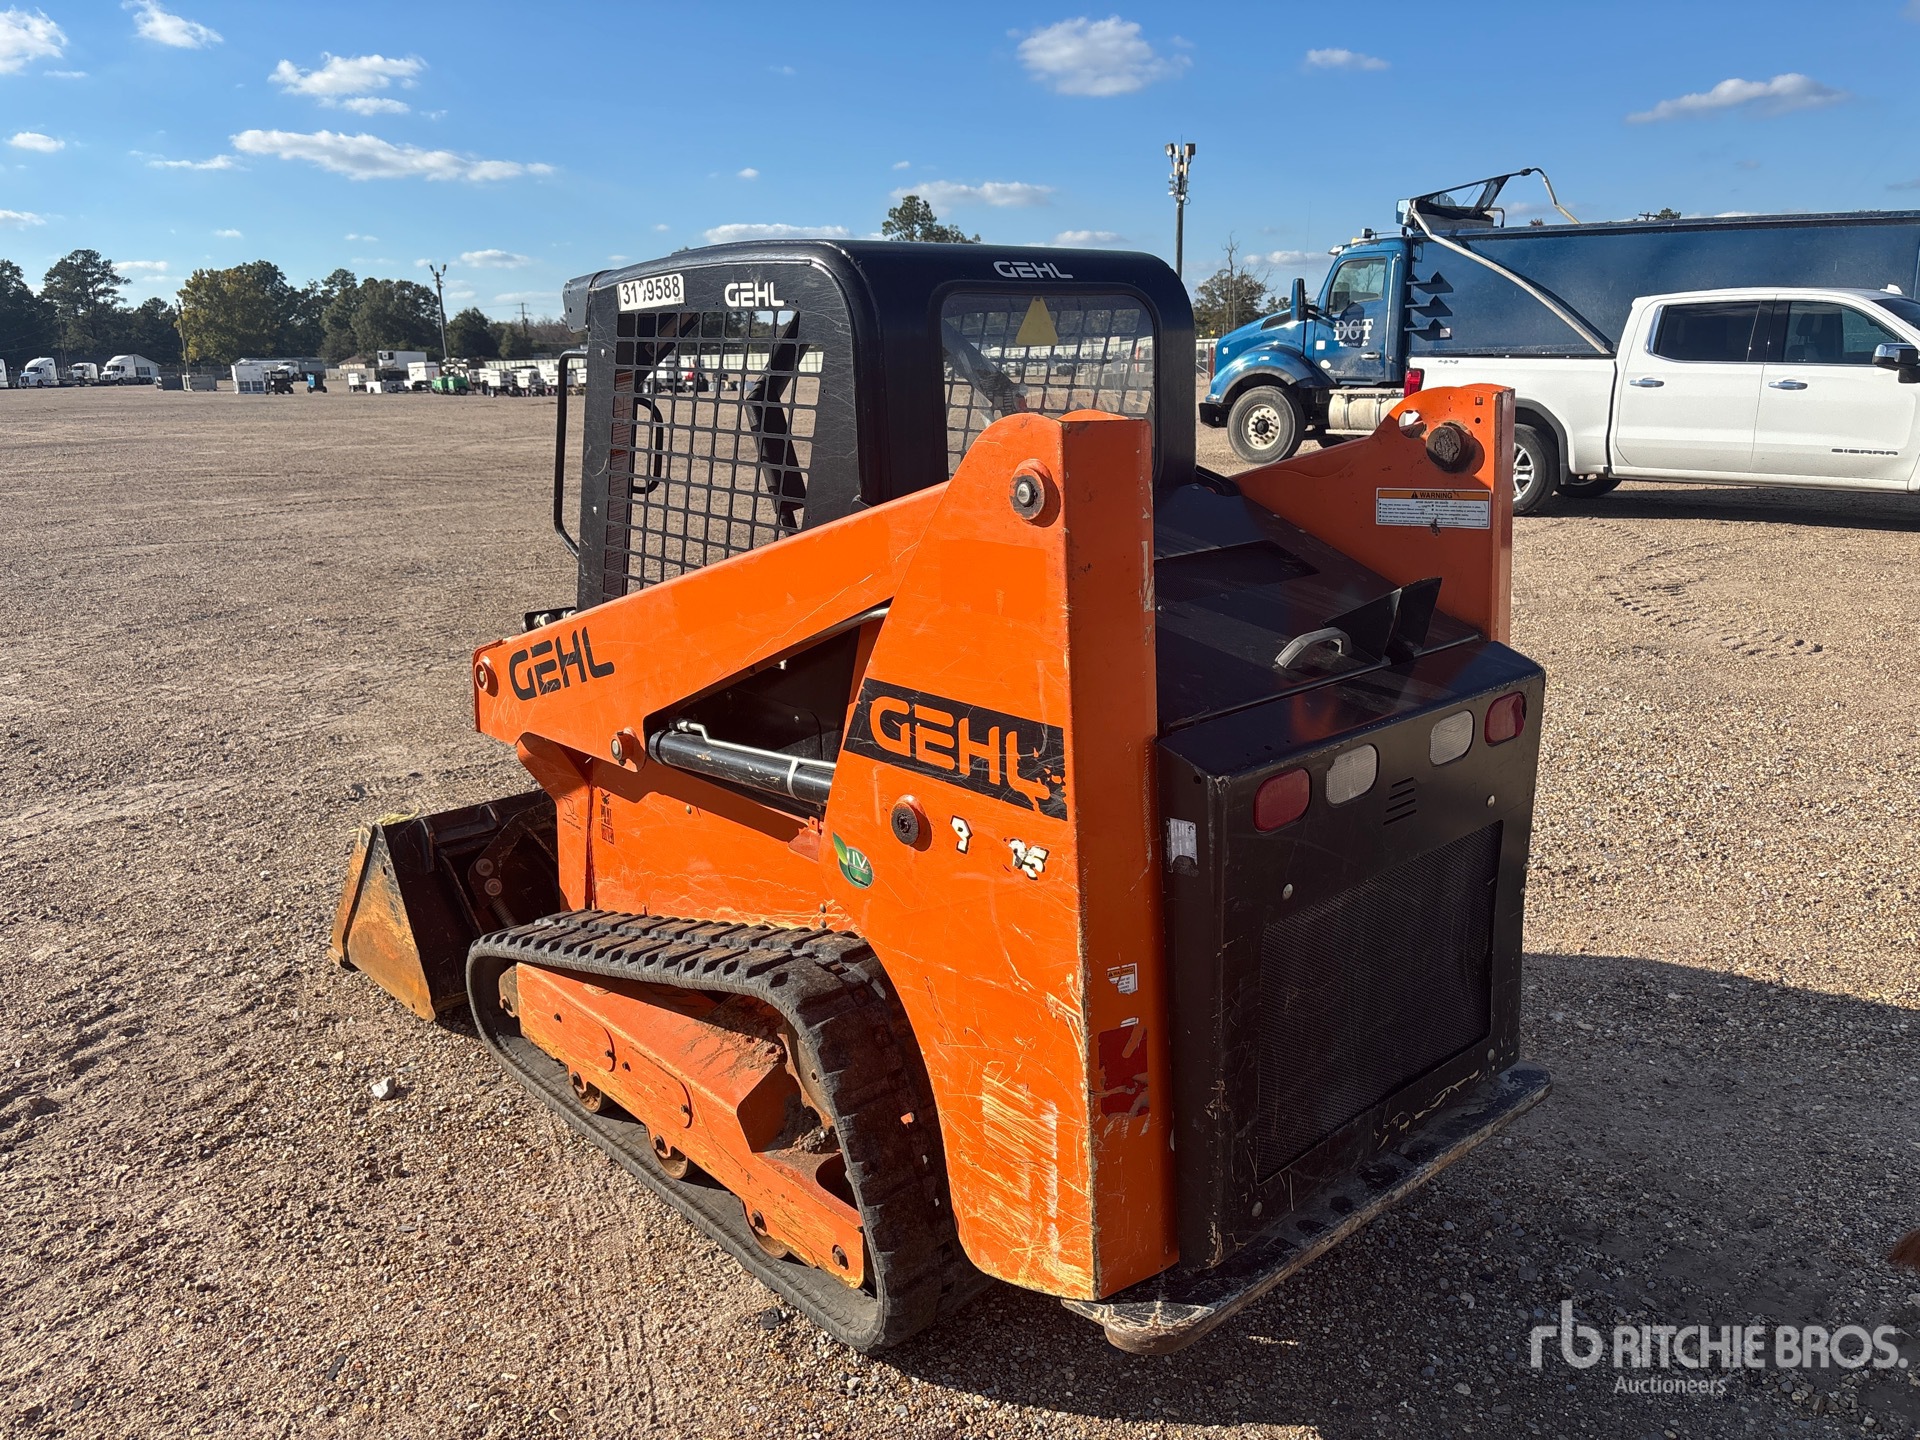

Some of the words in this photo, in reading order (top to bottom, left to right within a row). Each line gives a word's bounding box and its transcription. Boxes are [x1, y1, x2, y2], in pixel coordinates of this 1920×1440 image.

[993, 261, 1073, 279] GEHL
[724, 282, 785, 307] GEHL
[1333, 318, 1374, 341] DGT
[509, 626, 615, 701] GEHL
[869, 695, 1050, 801] GEHL
